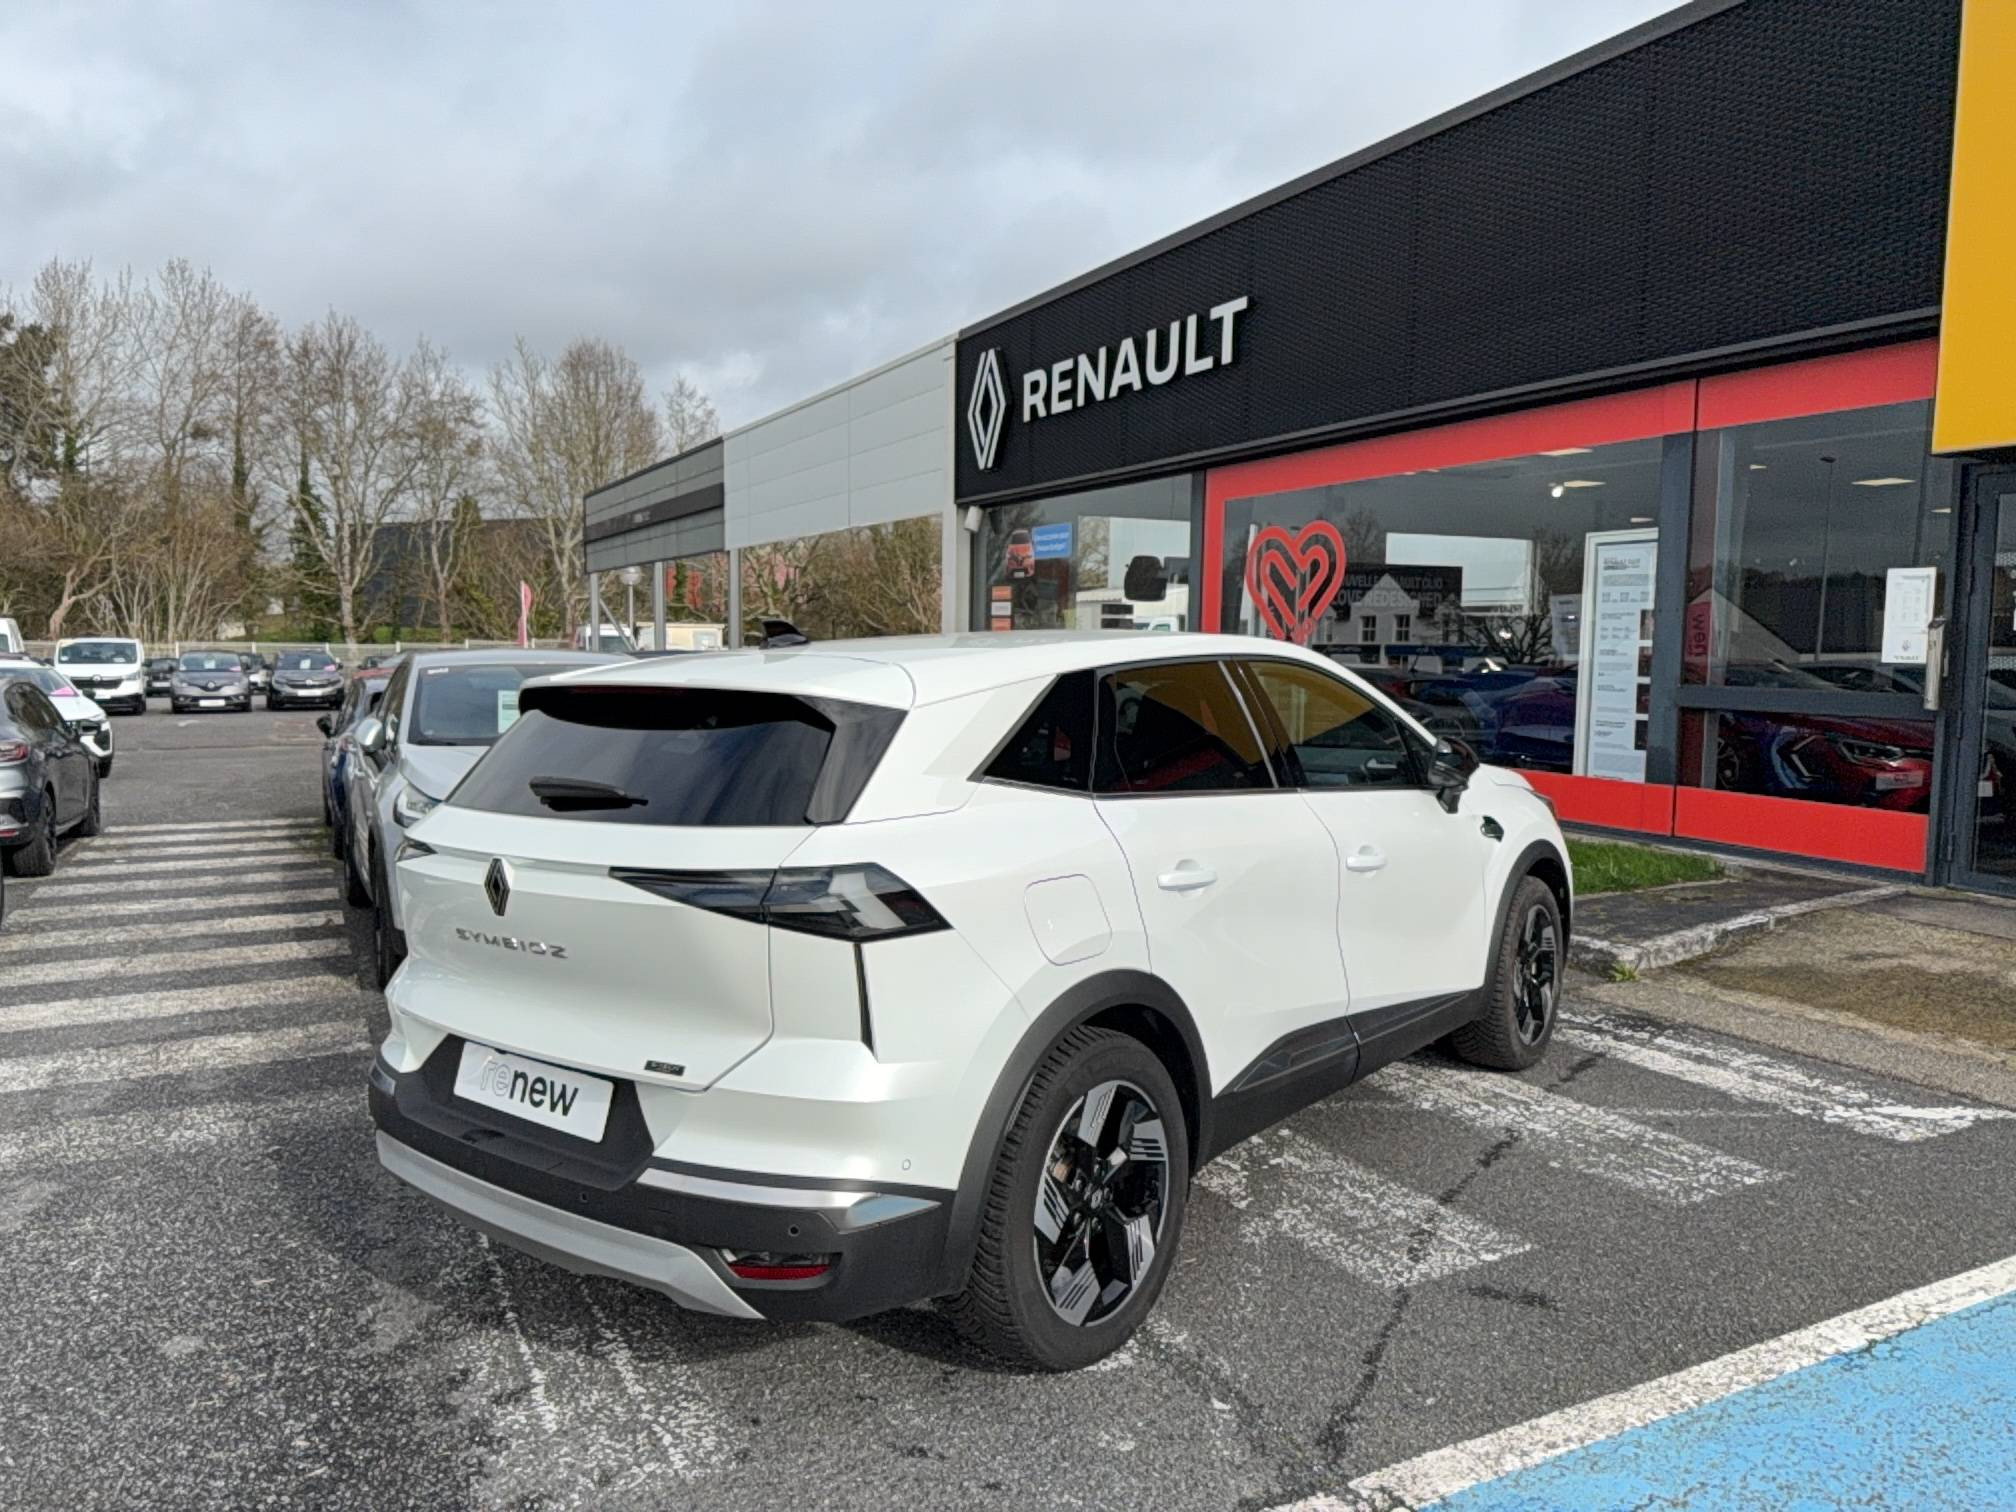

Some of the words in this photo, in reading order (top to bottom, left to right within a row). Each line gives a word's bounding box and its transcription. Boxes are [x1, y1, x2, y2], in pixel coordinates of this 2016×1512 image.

[1023, 296, 1248, 423] RENAULT
[456, 928, 568, 959] SYMBIOZ
[480, 1056, 579, 1116] renew
